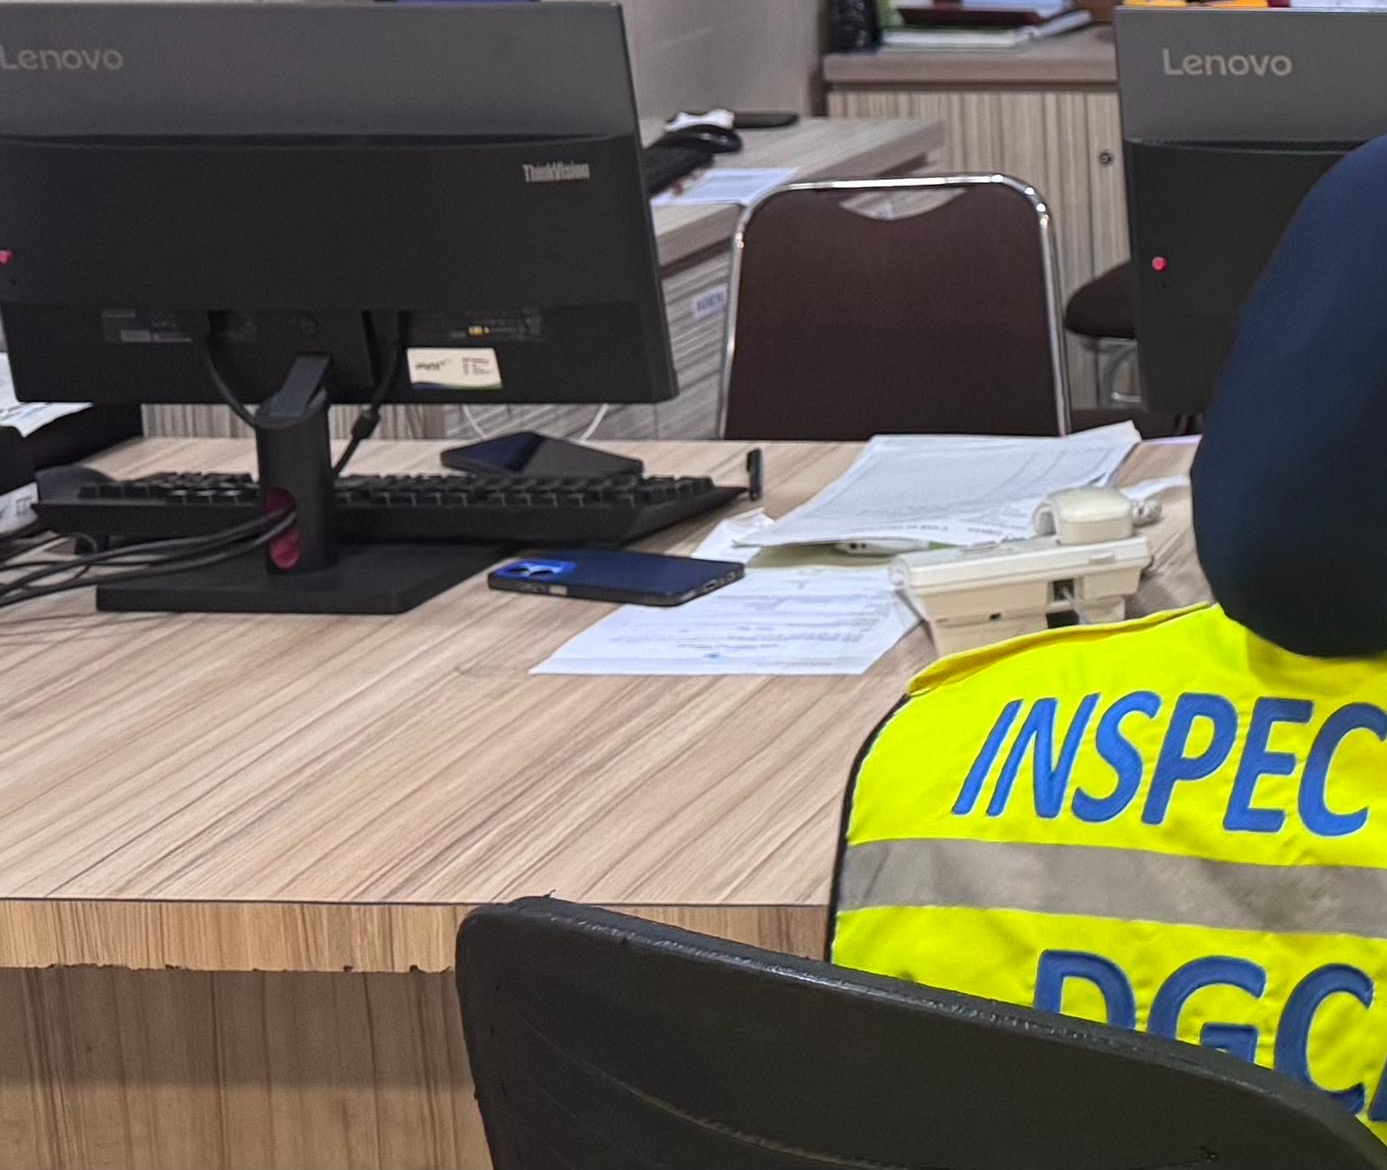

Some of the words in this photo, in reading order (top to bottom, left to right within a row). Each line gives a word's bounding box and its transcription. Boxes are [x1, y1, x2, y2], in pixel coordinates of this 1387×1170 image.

[0, 45, 123, 72] Lenovo
[1162, 48, 1293, 76] Lenovo
[522, 161, 591, 182] ThinkVision
